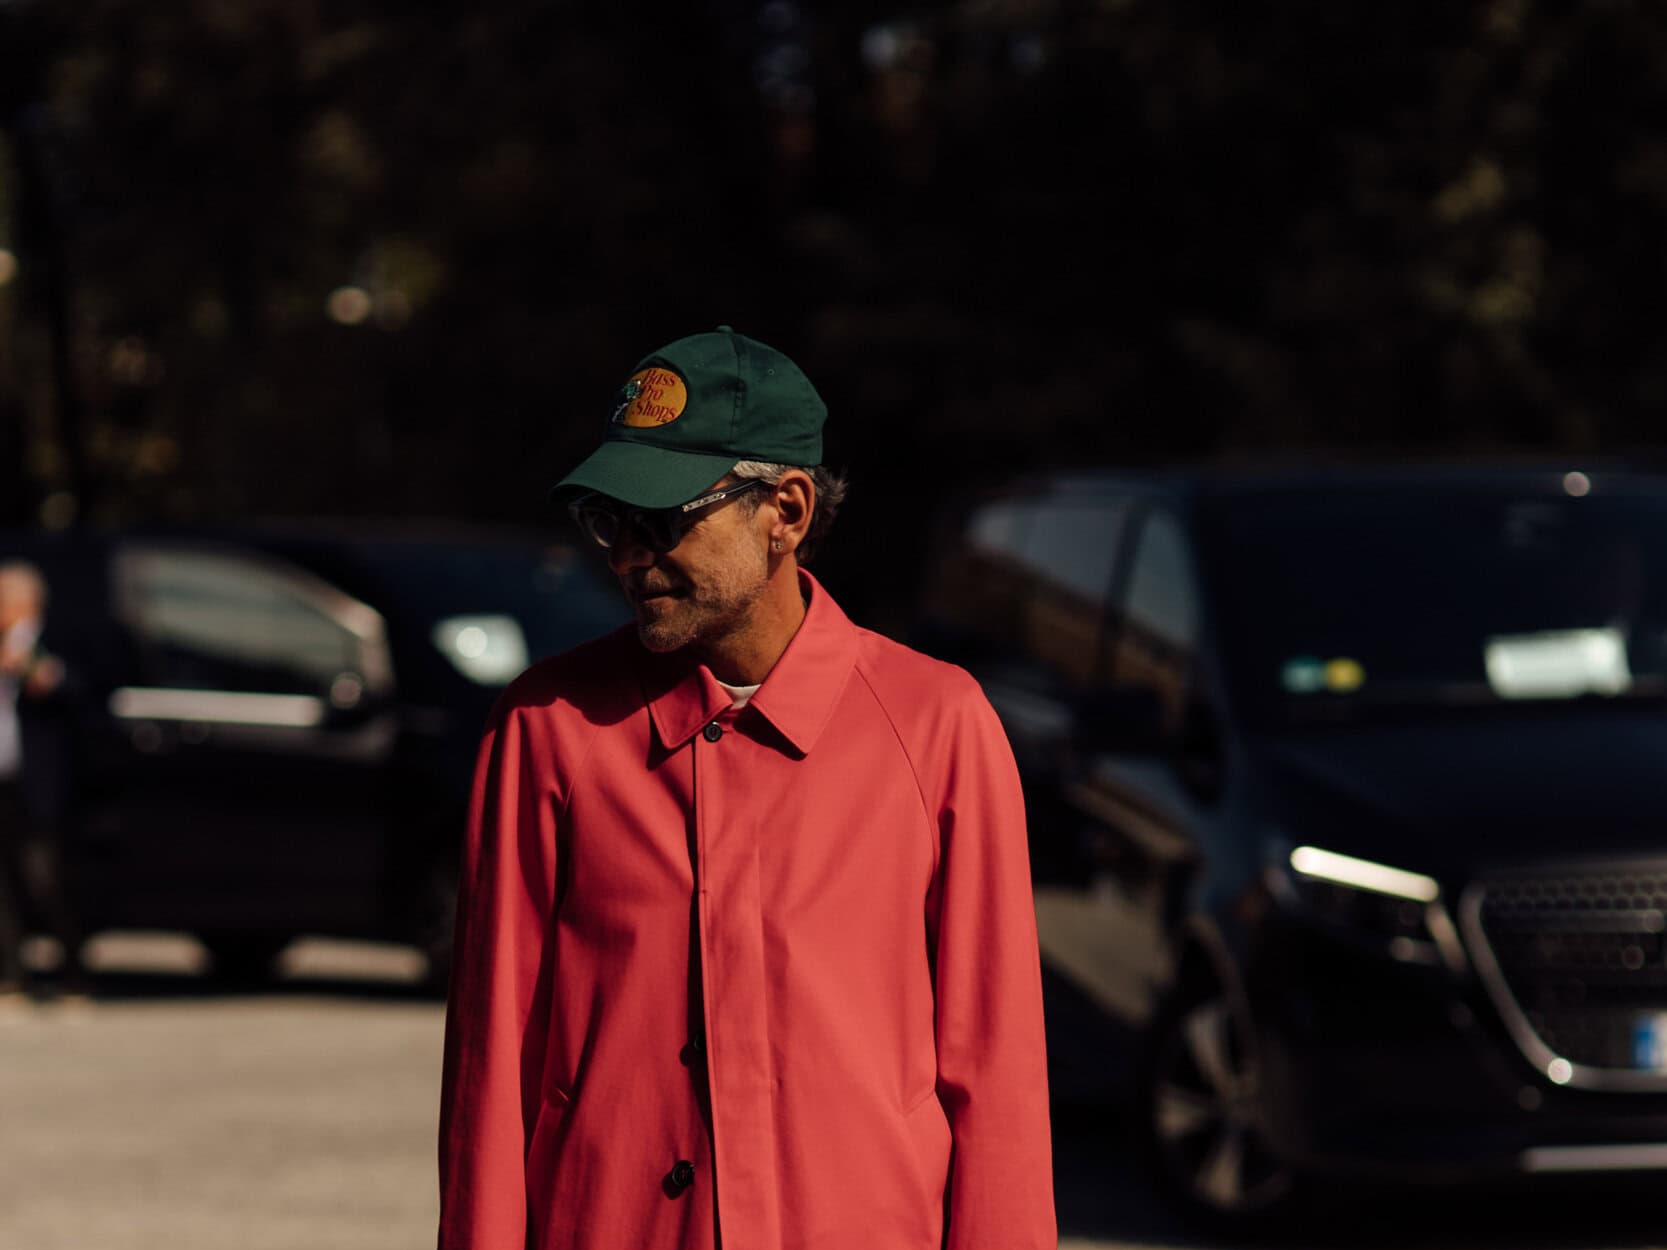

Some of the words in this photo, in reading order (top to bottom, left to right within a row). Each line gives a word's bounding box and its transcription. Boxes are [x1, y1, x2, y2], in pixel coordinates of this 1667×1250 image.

[643, 369, 676, 386] Bass
[641, 385, 664, 400] Pro
[632, 400, 676, 421] Shops
